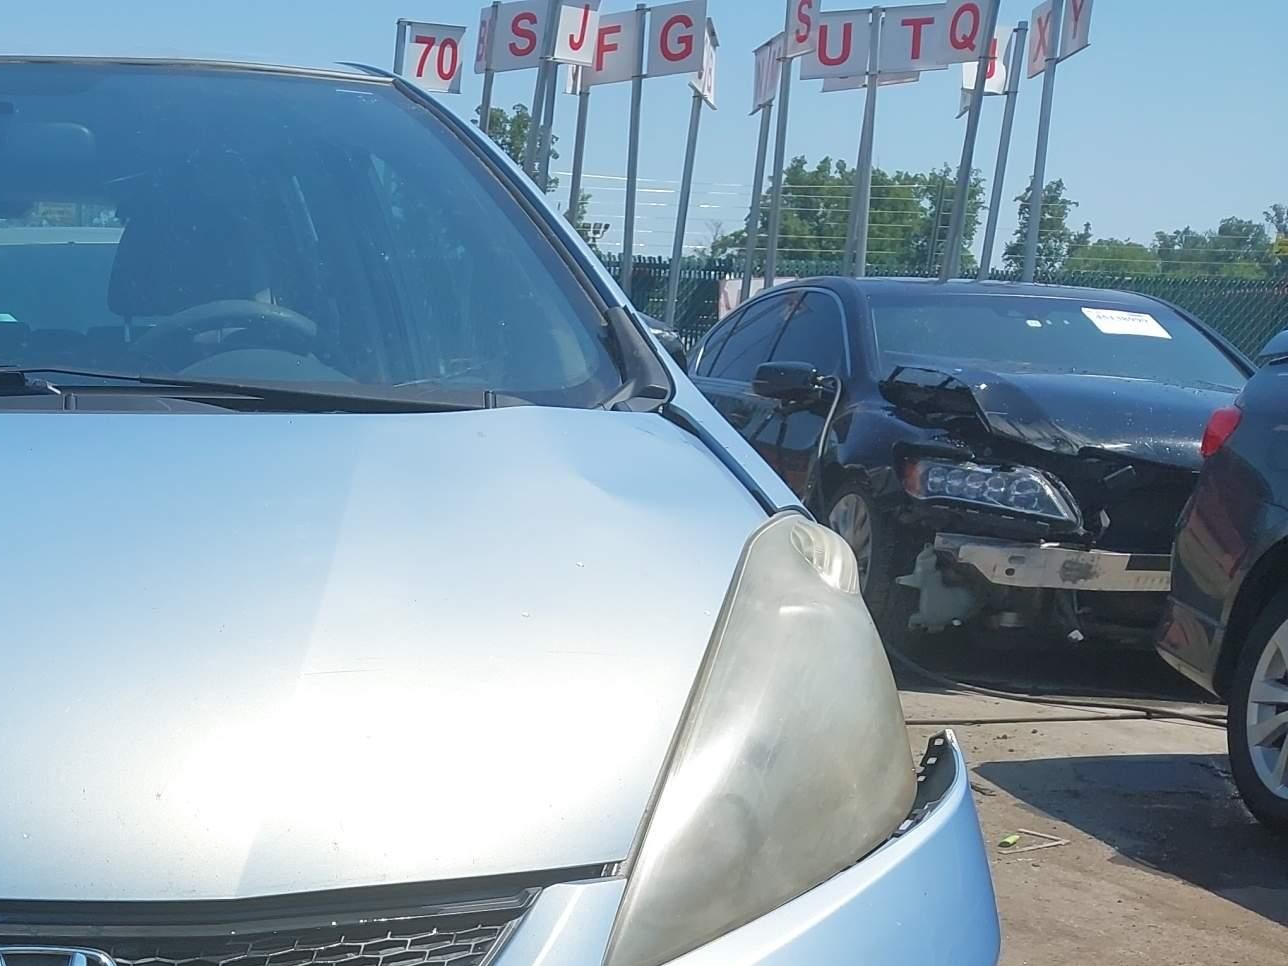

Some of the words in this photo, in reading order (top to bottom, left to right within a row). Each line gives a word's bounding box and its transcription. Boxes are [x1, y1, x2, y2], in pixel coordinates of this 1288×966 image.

[508, 11, 538, 57] S
[568, 4, 590, 51] J
[659, 14, 694, 62] G
[795, 0, 813, 44] S
[817, 22, 853, 66] U
[900, 17, 935, 60] T
[949, 2, 980, 52] Q
[1033, 10, 1053, 63] X
[415, 35, 458, 81] 70
[595, 25, 622, 72] F
